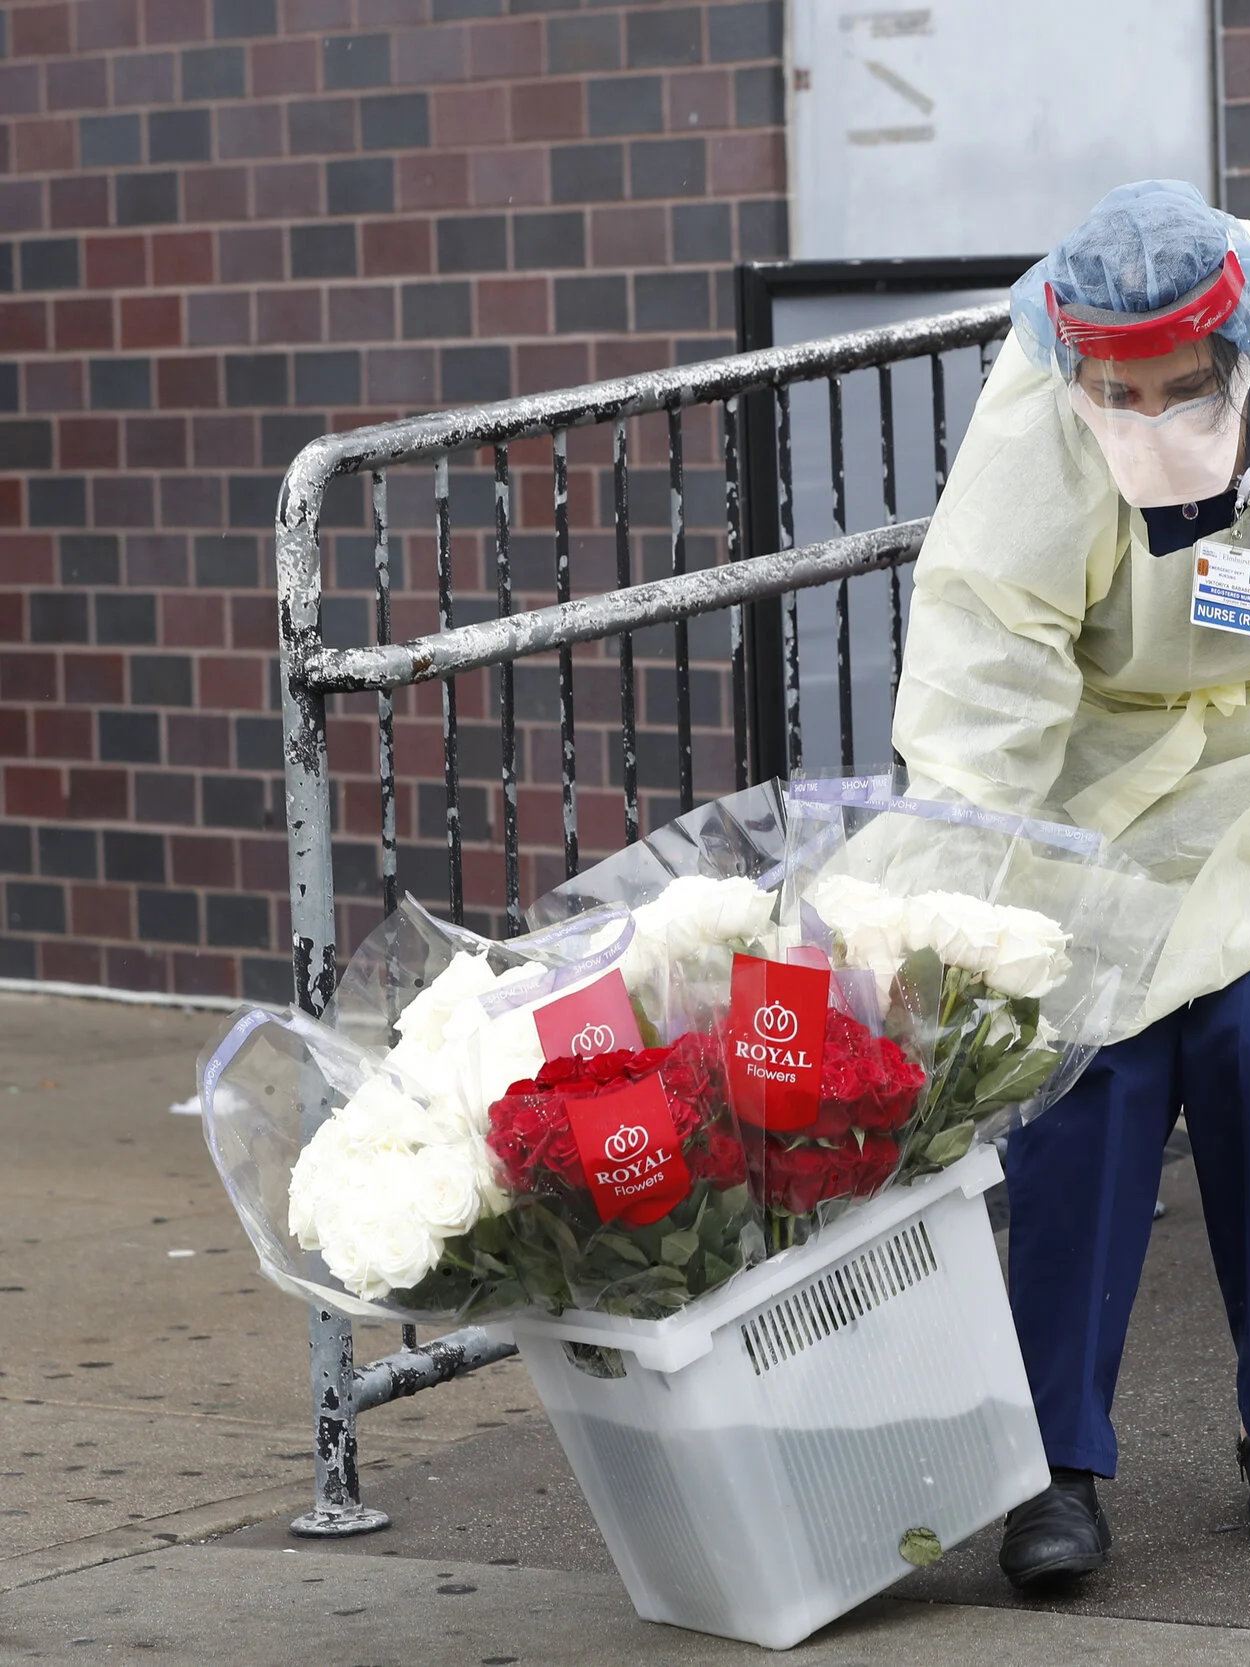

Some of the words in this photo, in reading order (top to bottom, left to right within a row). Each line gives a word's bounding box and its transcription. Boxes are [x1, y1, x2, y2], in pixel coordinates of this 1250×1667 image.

[1197, 604, 1236, 623] NURSE
[841, 780, 868, 790] SHOW
[573, 957, 602, 973] SHOW
[602, 942, 622, 960] TIME
[734, 1039, 812, 1069] ROYAL
[746, 1063, 797, 1084] Flowers
[594, 1149, 672, 1187] ROYAL
[614, 1171, 665, 1197] Flowers
